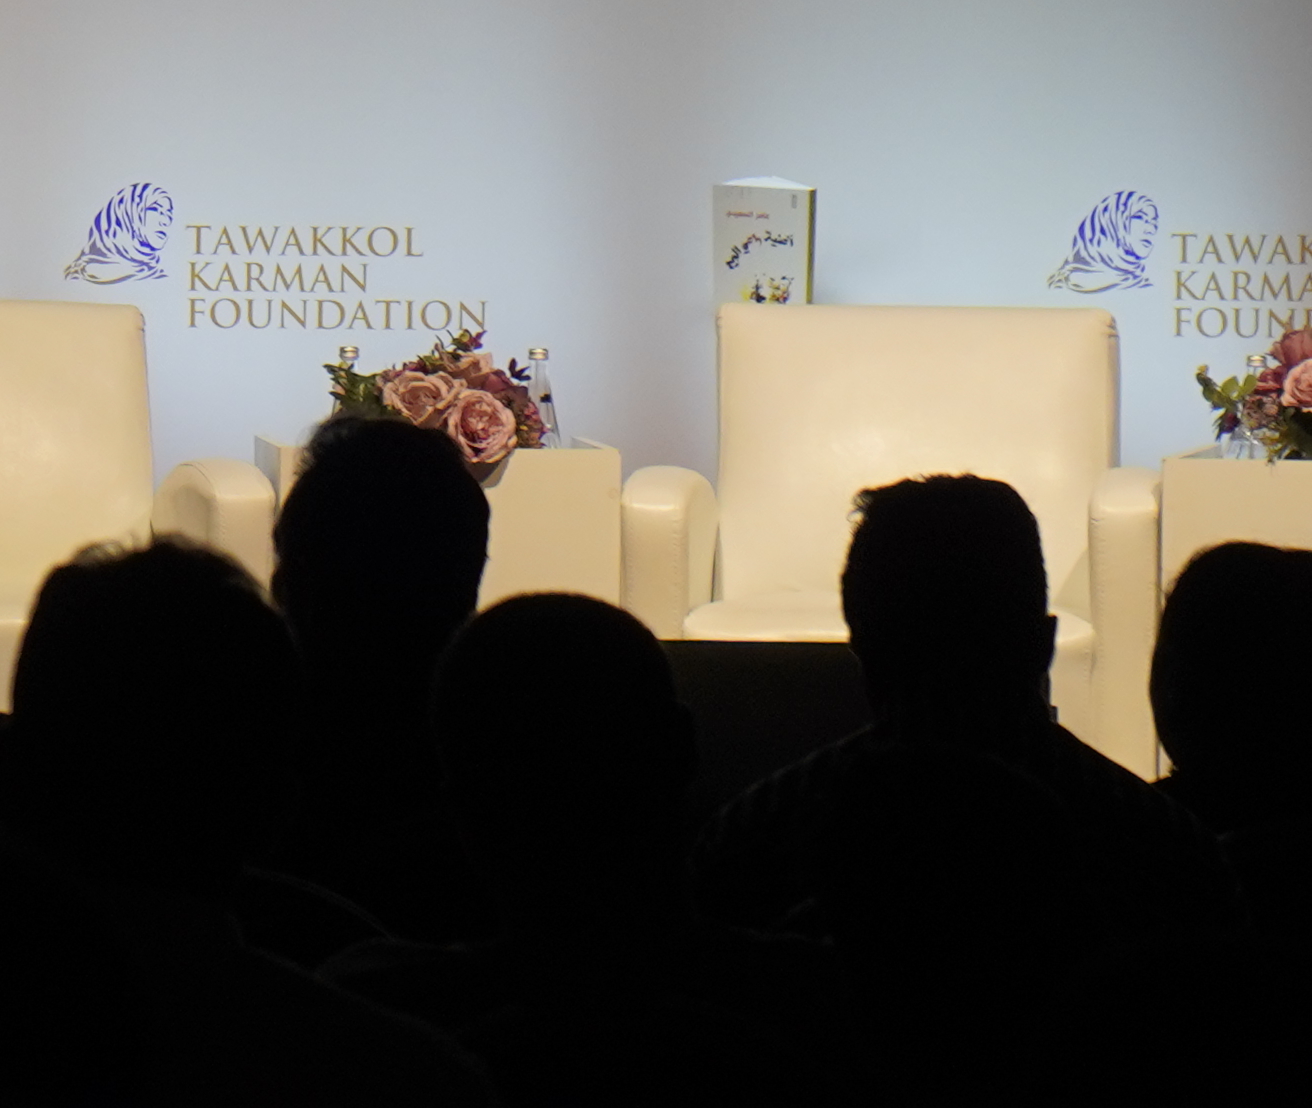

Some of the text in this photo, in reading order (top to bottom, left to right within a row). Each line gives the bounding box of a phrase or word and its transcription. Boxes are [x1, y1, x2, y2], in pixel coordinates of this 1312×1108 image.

[185, 224, 424, 258] TAWAKKOL
[189, 261, 368, 294] KARMAN
[188, 297, 488, 332] FOUNDATION
